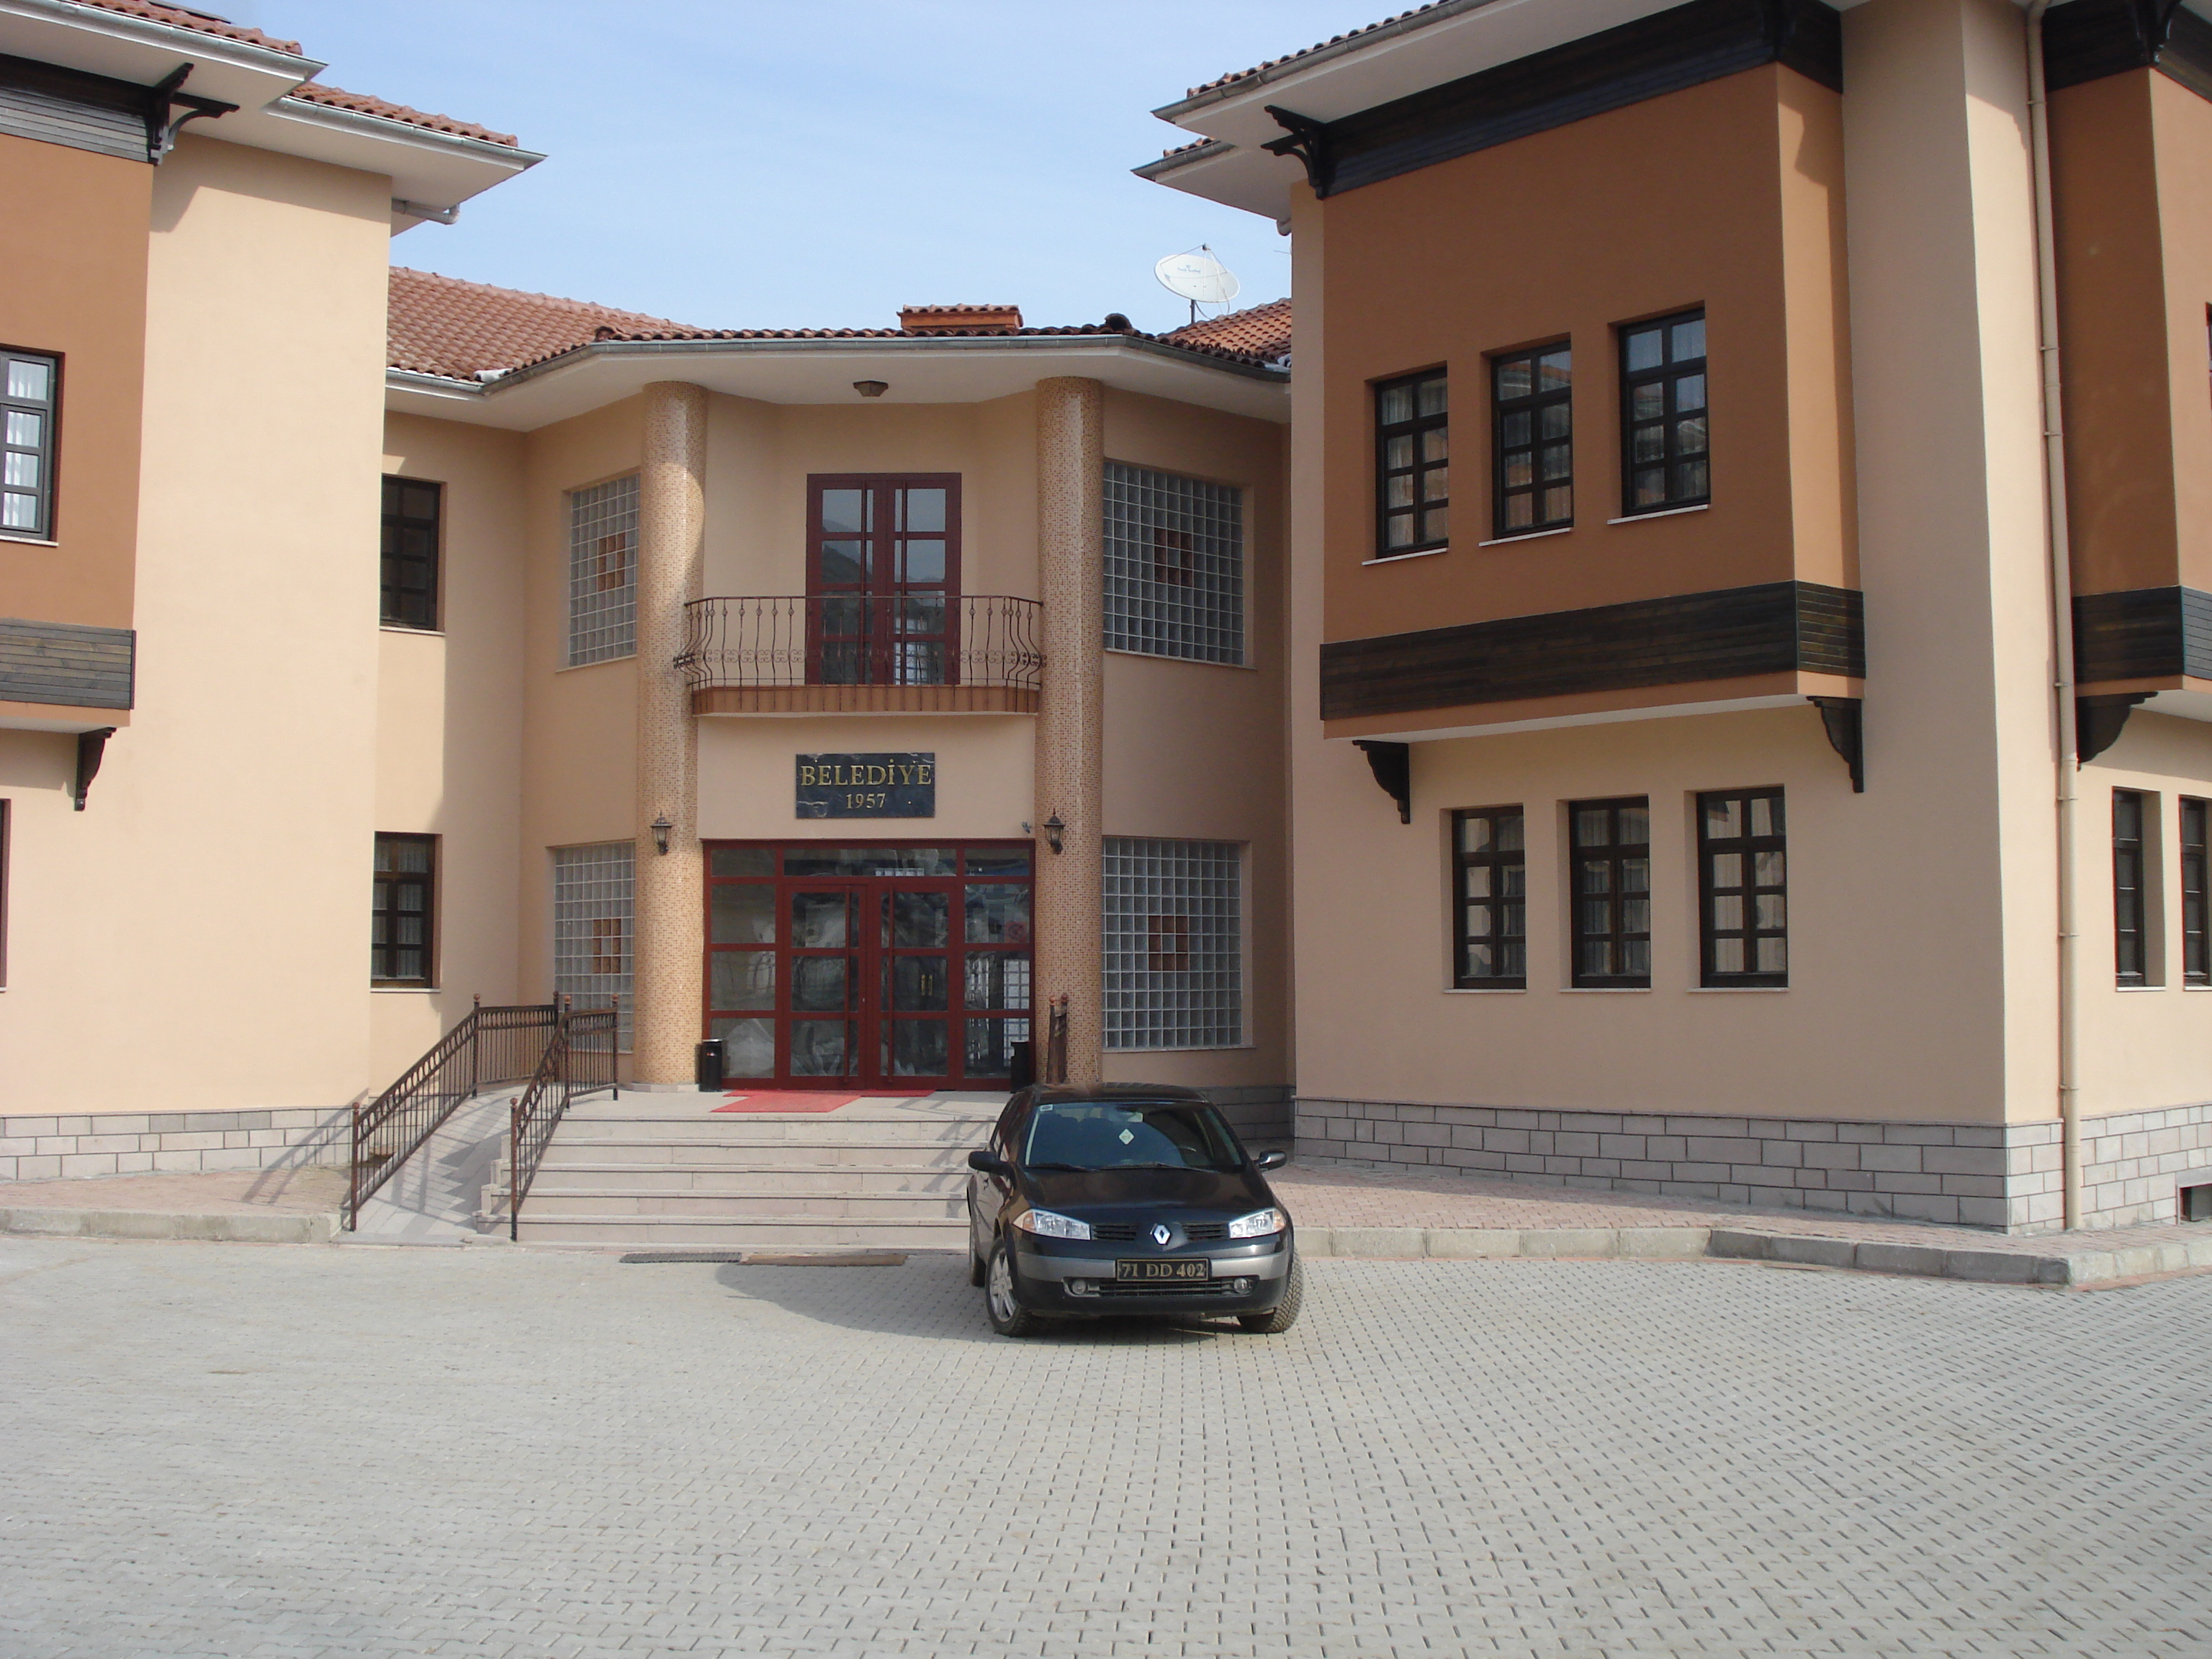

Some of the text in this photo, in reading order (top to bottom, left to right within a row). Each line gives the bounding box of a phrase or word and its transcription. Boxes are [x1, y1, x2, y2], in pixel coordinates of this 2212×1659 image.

[801, 759, 931, 786] BELEDİYE
[845, 793, 886, 809] 1957
[1122, 1263, 1205, 1277] 71 DD 402
